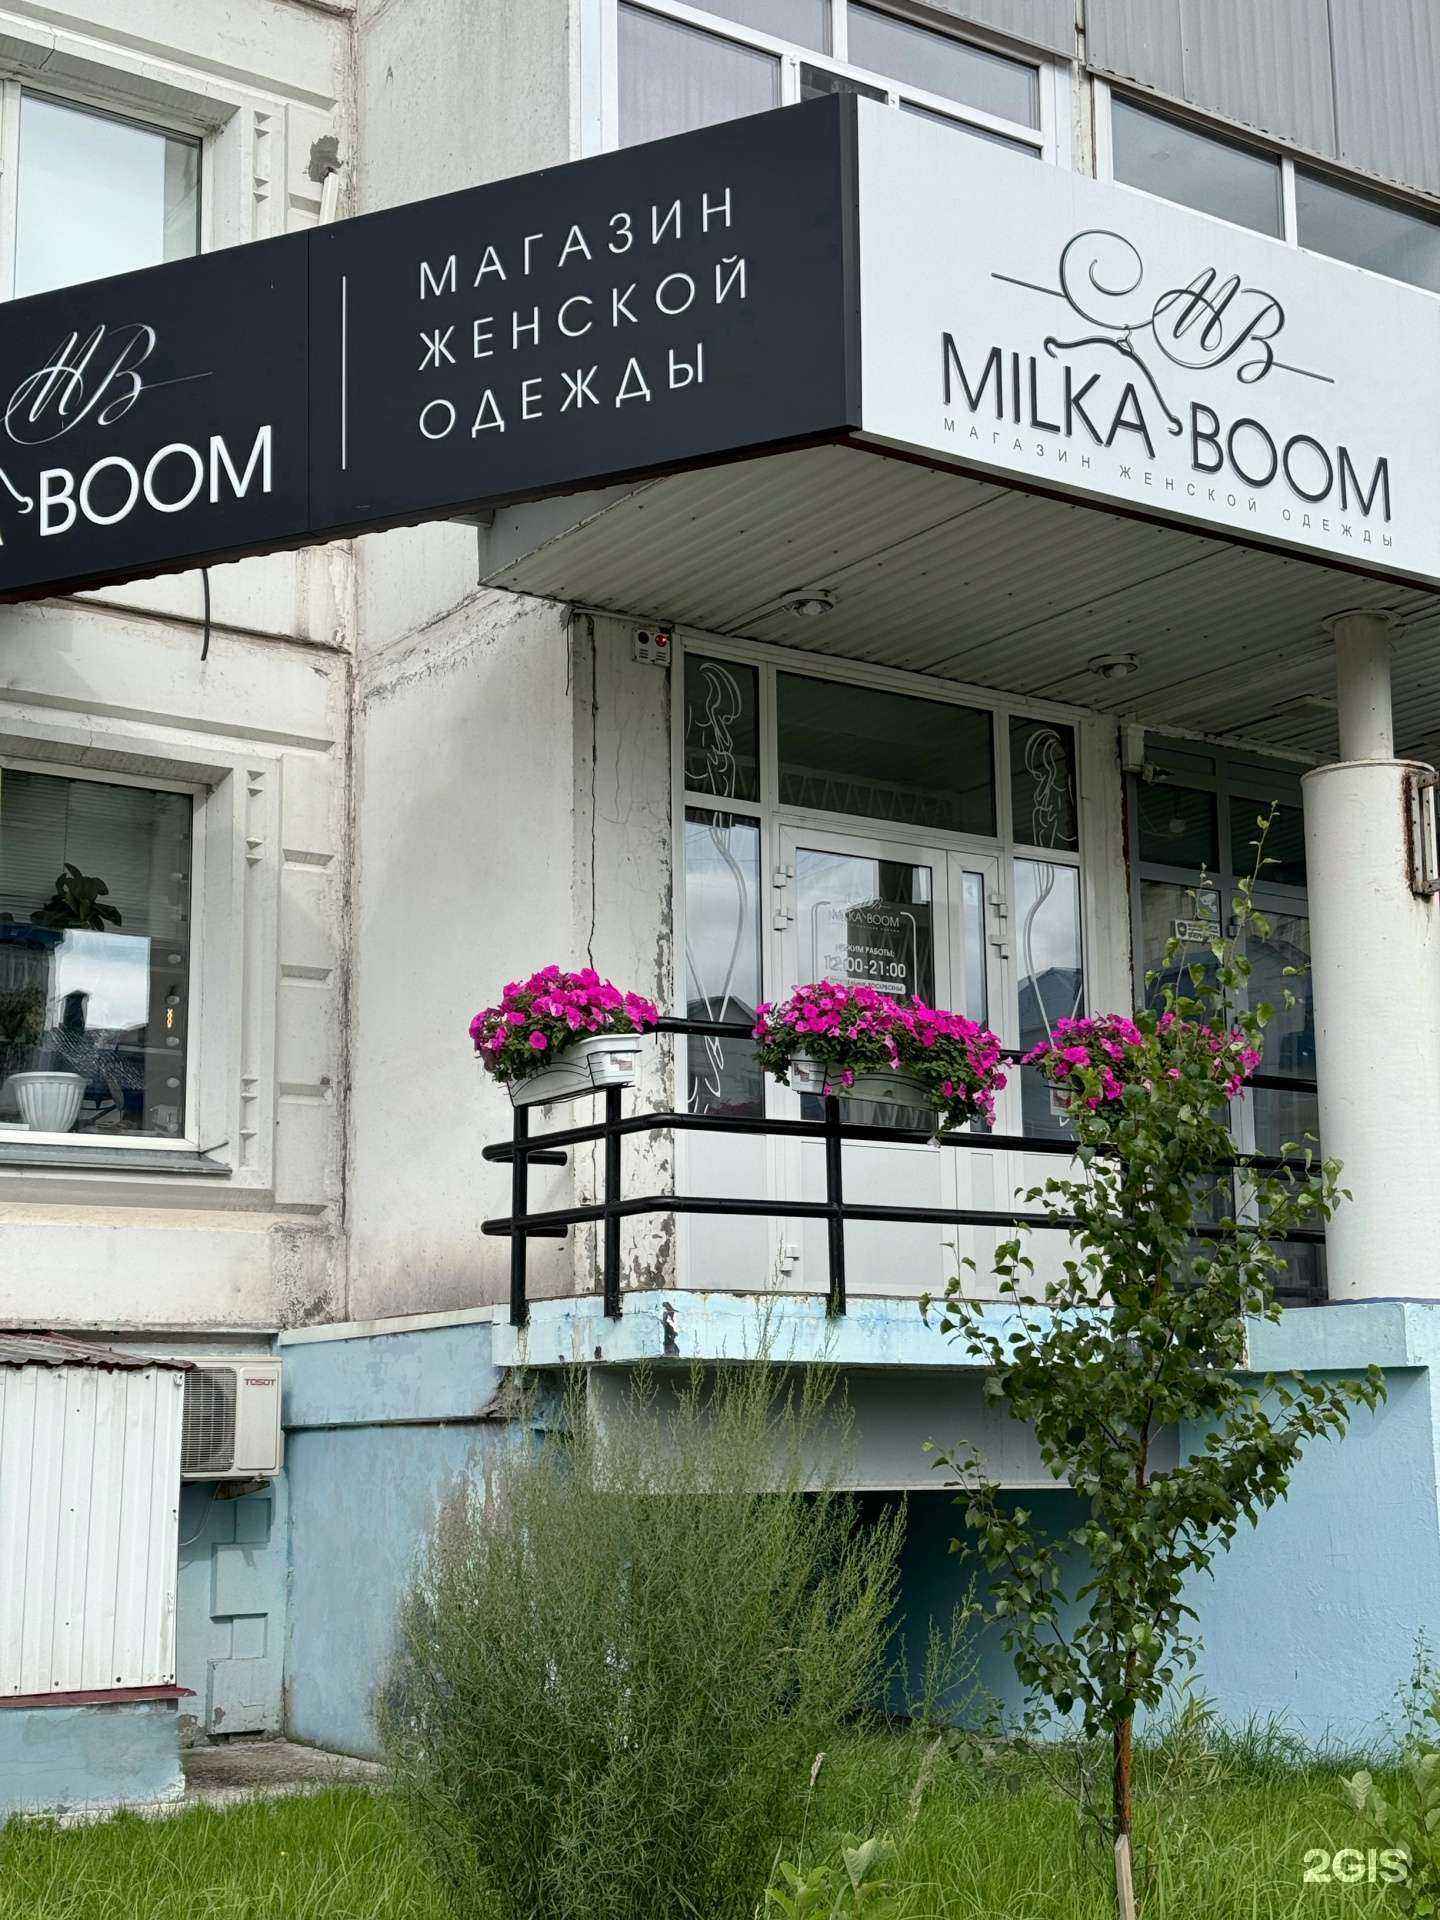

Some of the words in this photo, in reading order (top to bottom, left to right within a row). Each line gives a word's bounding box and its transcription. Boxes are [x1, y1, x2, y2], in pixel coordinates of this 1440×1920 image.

[419, 187, 732, 300] МАГАЗИН
[418, 254, 747, 371] ЖЕНСКОЙ
[418, 342, 704, 440] ОДЕЖДЫ
[941, 331, 1157, 460] MILKA
[1189, 401, 1392, 523] BOOM
[39, 424, 272, 537] BOOM
[943, 417, 1091, 469] МАГАЗИН
[1118, 464, 1257, 512] ЖЕНСКОЙ
[1281, 508, 1393, 547] ОДЕЖДЫ
[866, 913, 900, 928] BOOM
[244, 1378, 276, 1386] TOSOT
